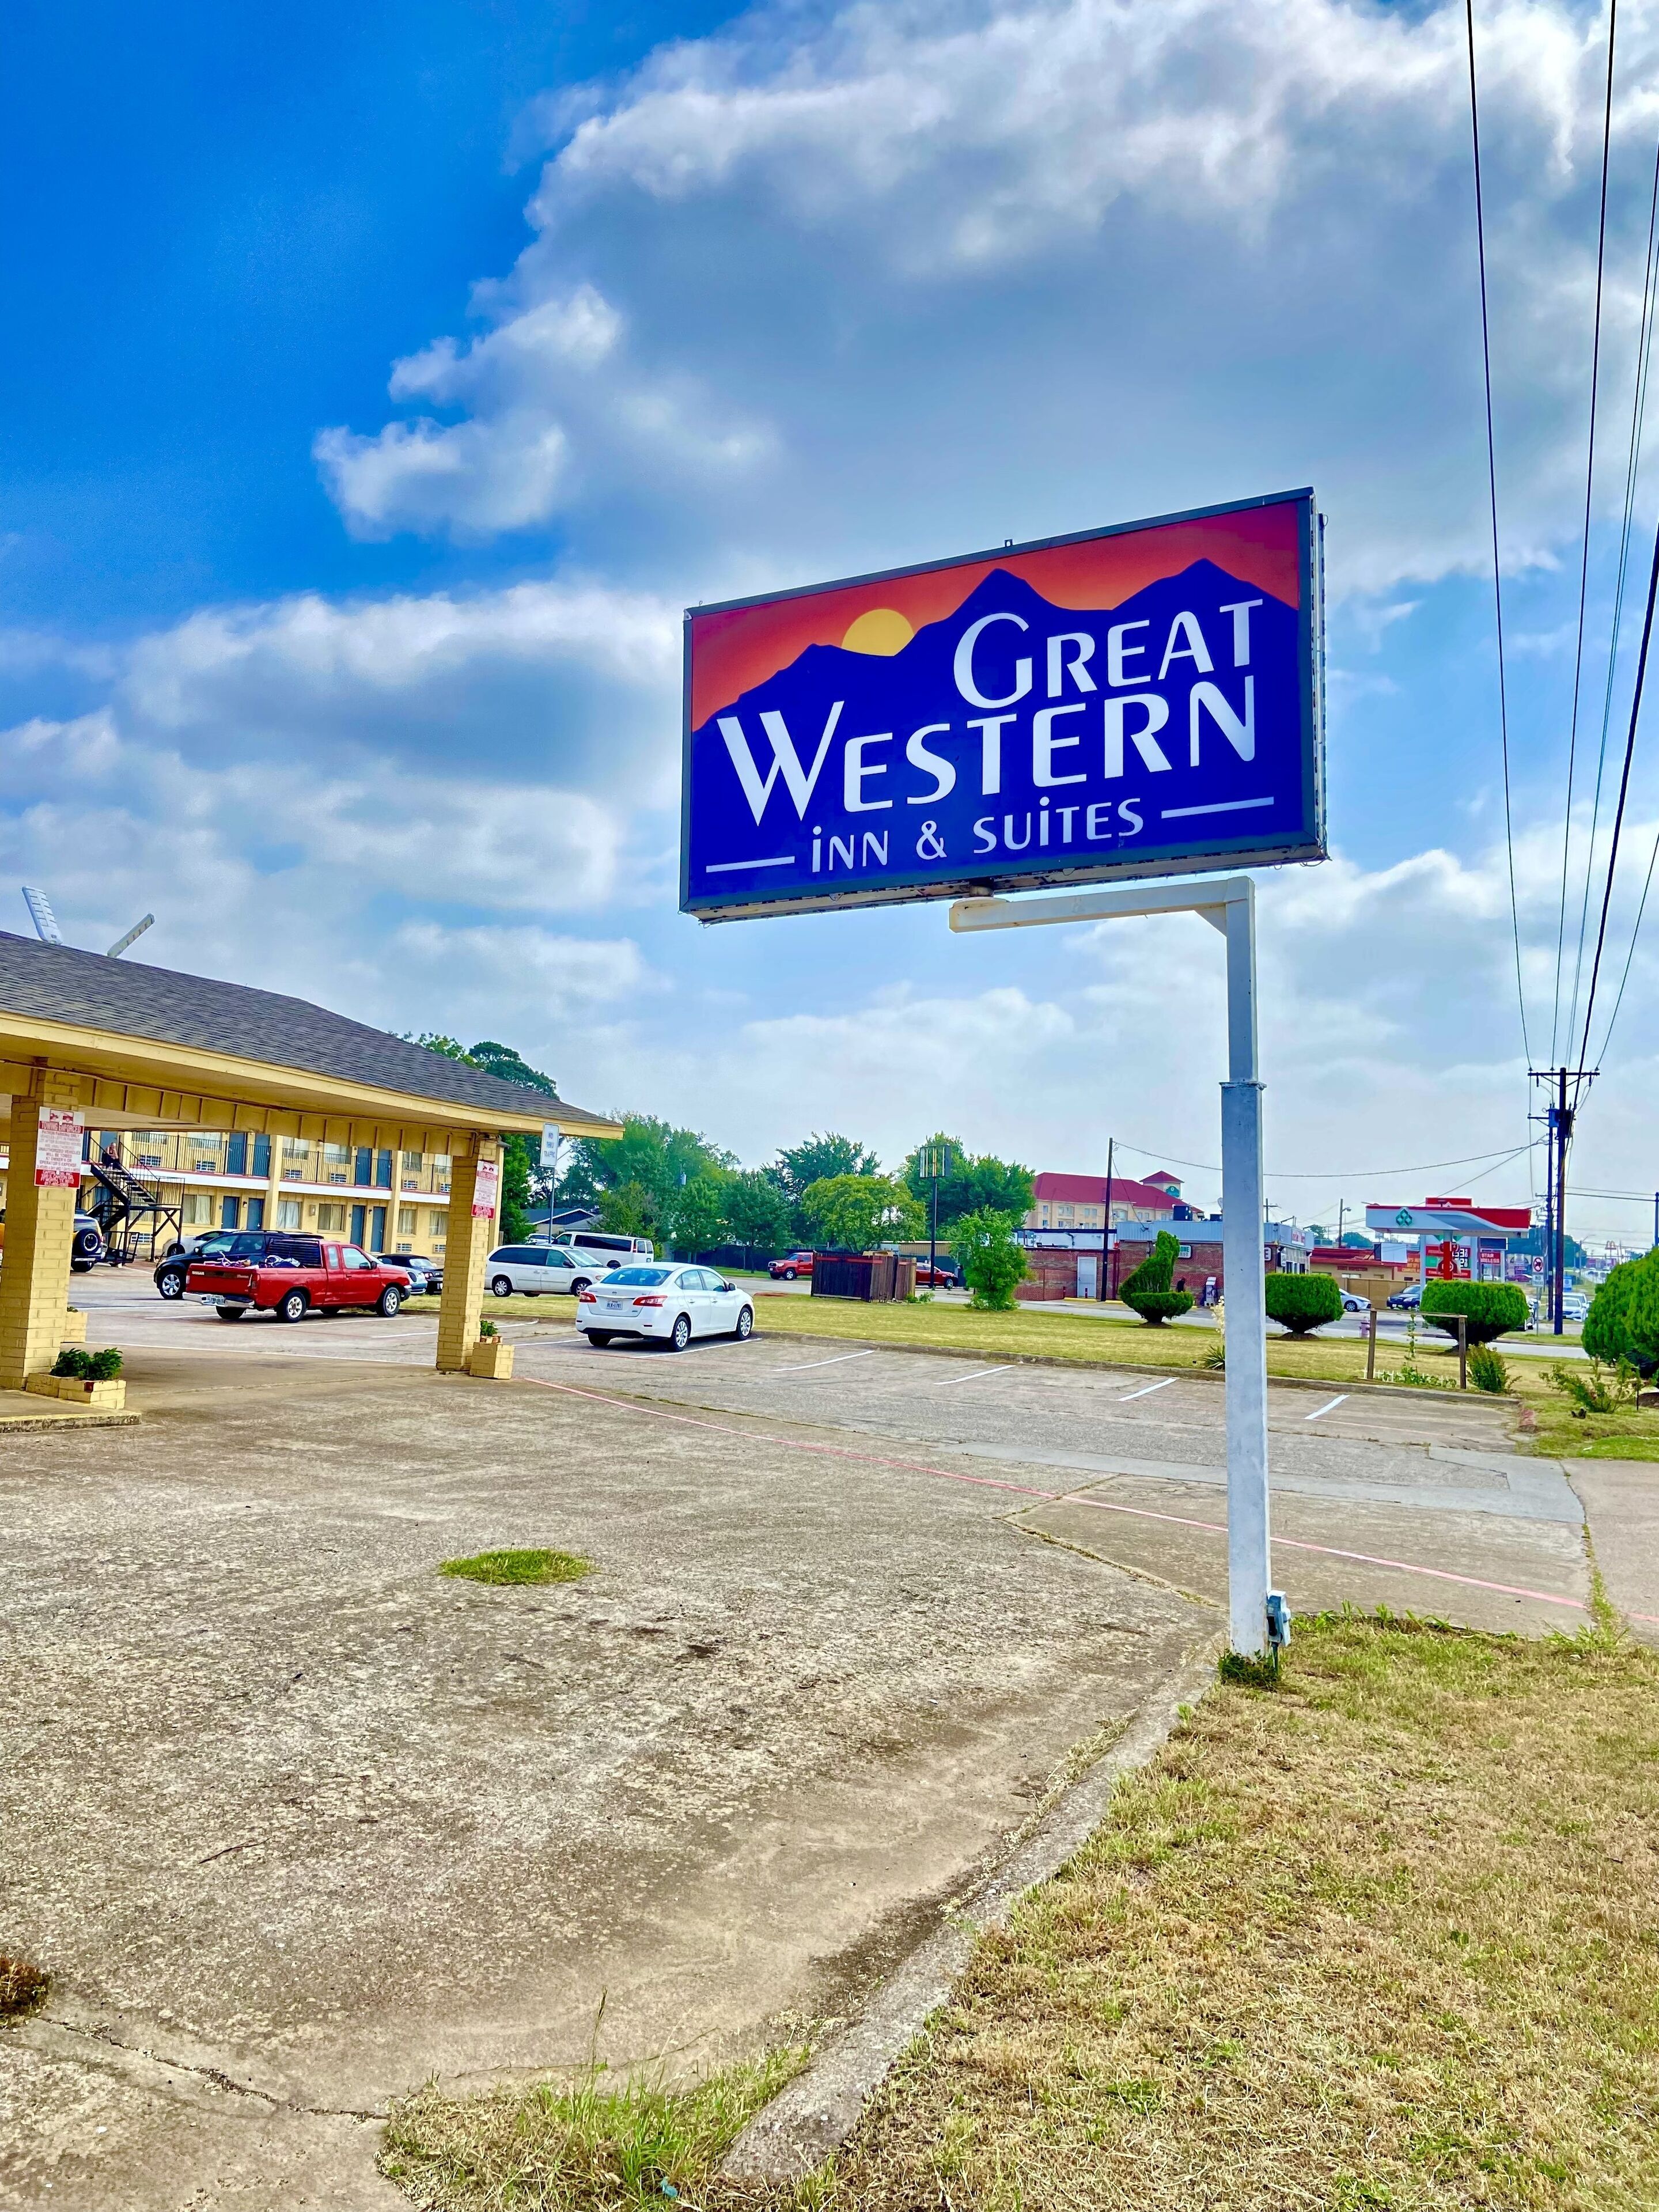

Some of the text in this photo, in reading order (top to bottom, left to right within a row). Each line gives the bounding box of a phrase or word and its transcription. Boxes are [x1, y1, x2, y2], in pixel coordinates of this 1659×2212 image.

[953, 599, 1263, 709] GREAT
[717, 675, 1256, 826] WESTERN
[916, 821, 946, 859] &
[41, 1121, 81, 1134] TOWING ENFORCED
